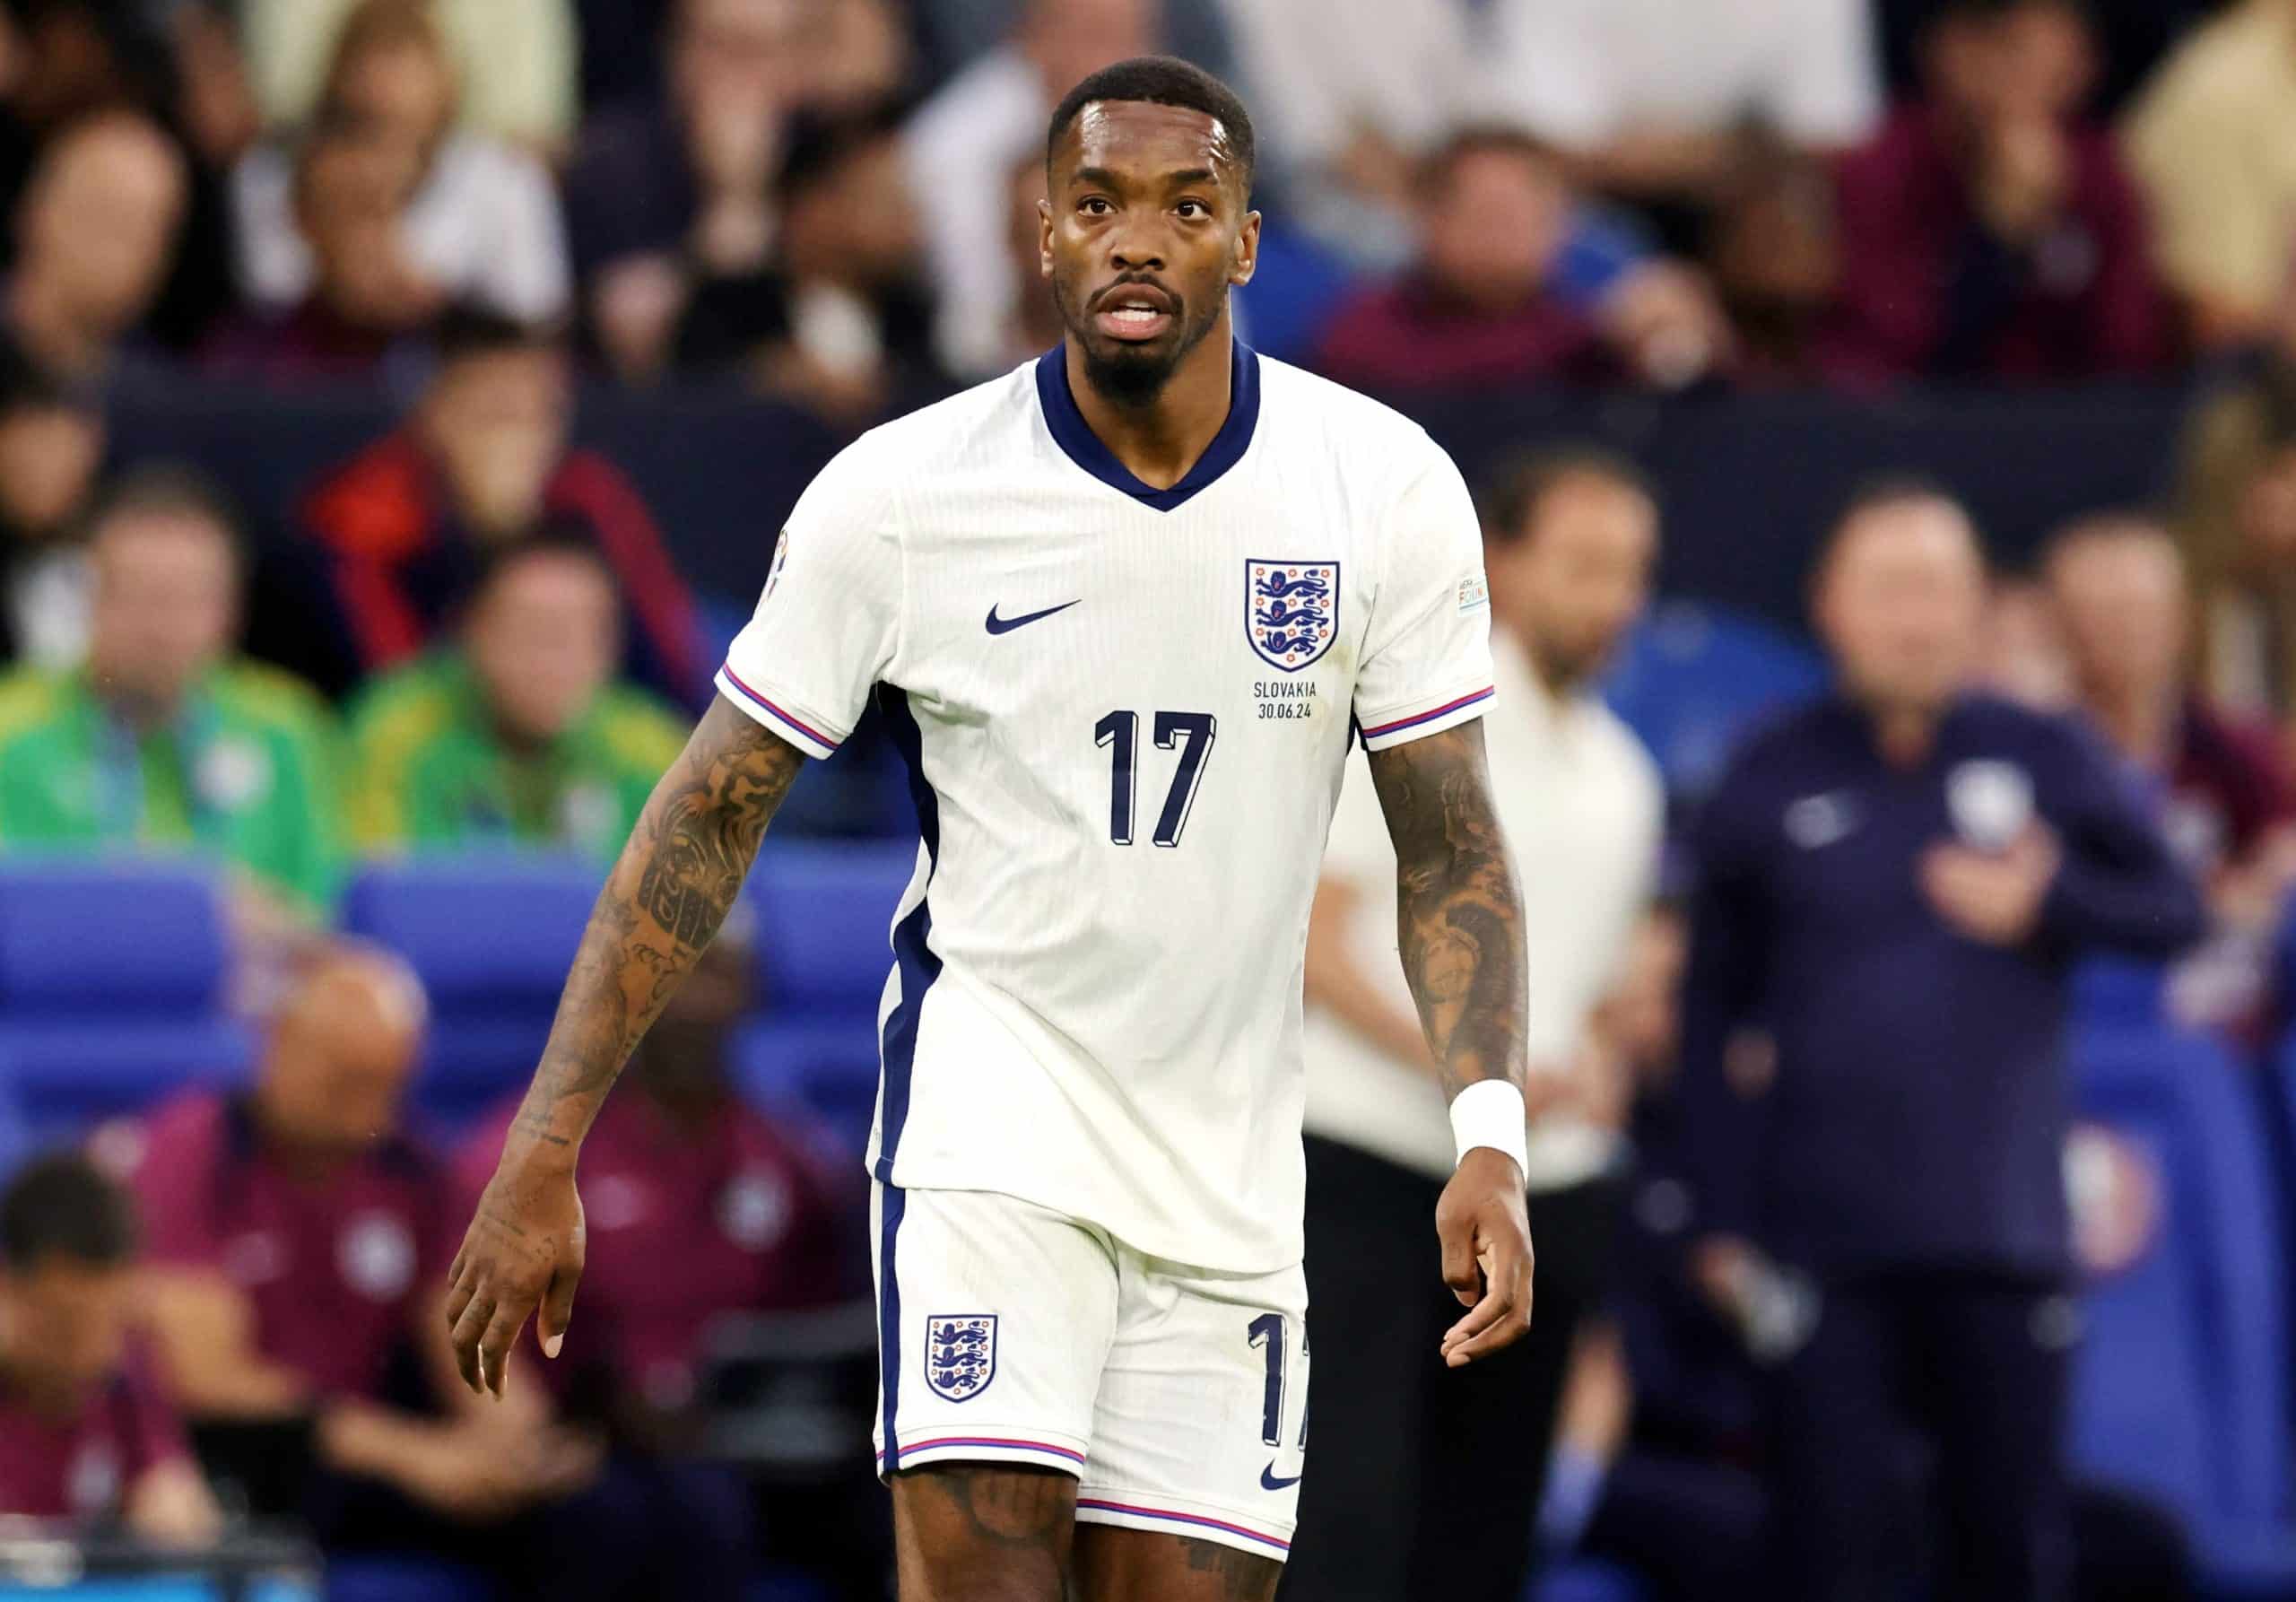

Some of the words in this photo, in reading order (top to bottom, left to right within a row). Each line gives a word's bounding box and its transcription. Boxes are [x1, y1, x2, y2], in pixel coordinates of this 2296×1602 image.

[1254, 682, 1317, 698] SLOVAKIA
[1258, 703, 1311, 718] 30.06.24
[1094, 710, 1217, 848] 17
[1248, 1313, 1309, 1451] 1
